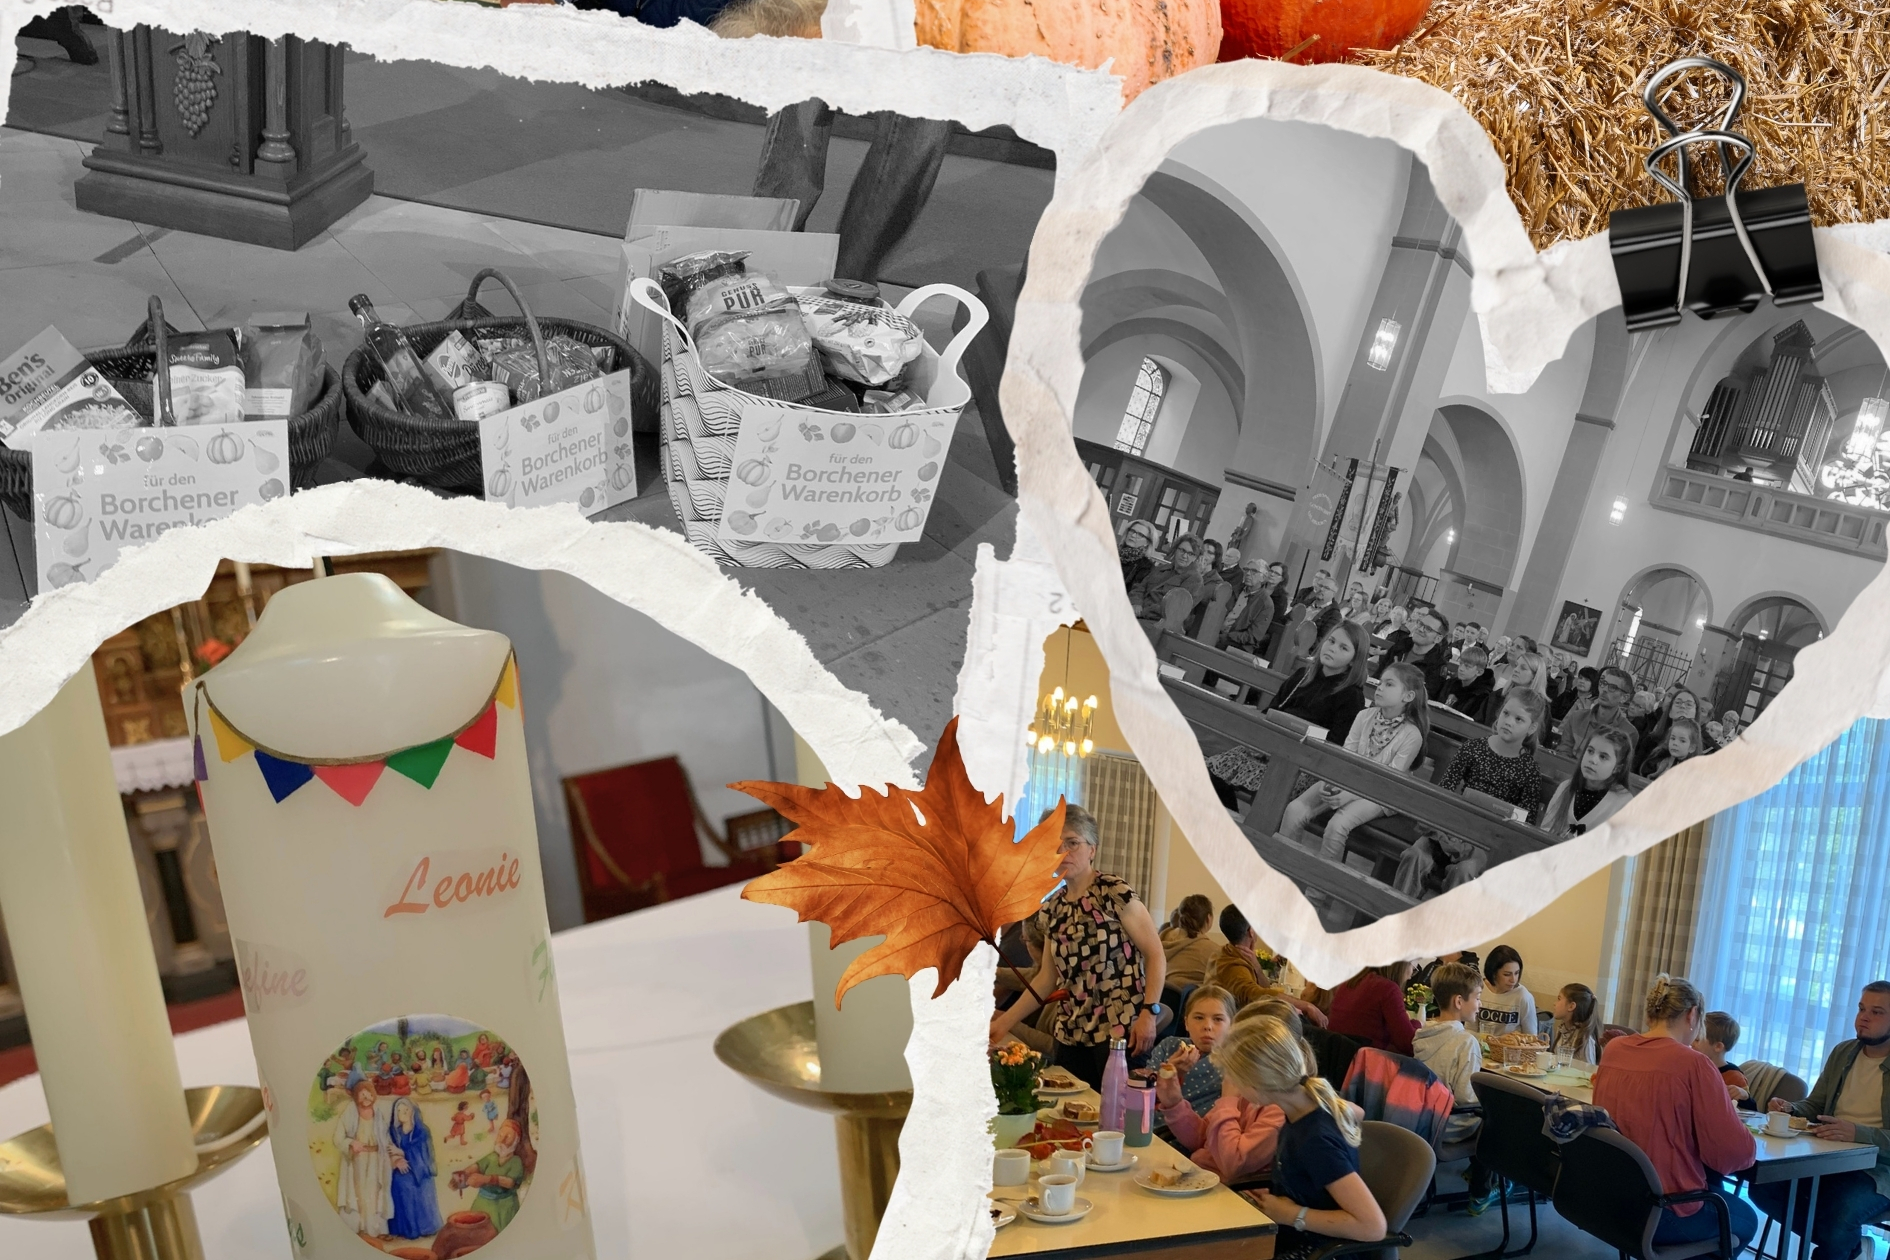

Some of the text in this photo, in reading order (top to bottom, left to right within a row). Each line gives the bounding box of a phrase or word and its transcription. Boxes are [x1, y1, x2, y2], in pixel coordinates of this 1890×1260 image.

[723, 289, 766, 311] PUR
[548, 426, 578, 445] für den
[522, 432, 602, 476] Borchener
[829, 453, 873, 464] für den
[168, 473, 196, 486] den
[521, 447, 608, 497] Warenkorb
[786, 463, 903, 483] Borchener
[100, 489, 239, 516] Borchener
[781, 483, 901, 503] Warenkorb
[384, 852, 521, 918] Leonie
[1480, 1009, 1516, 1023] OGUE
